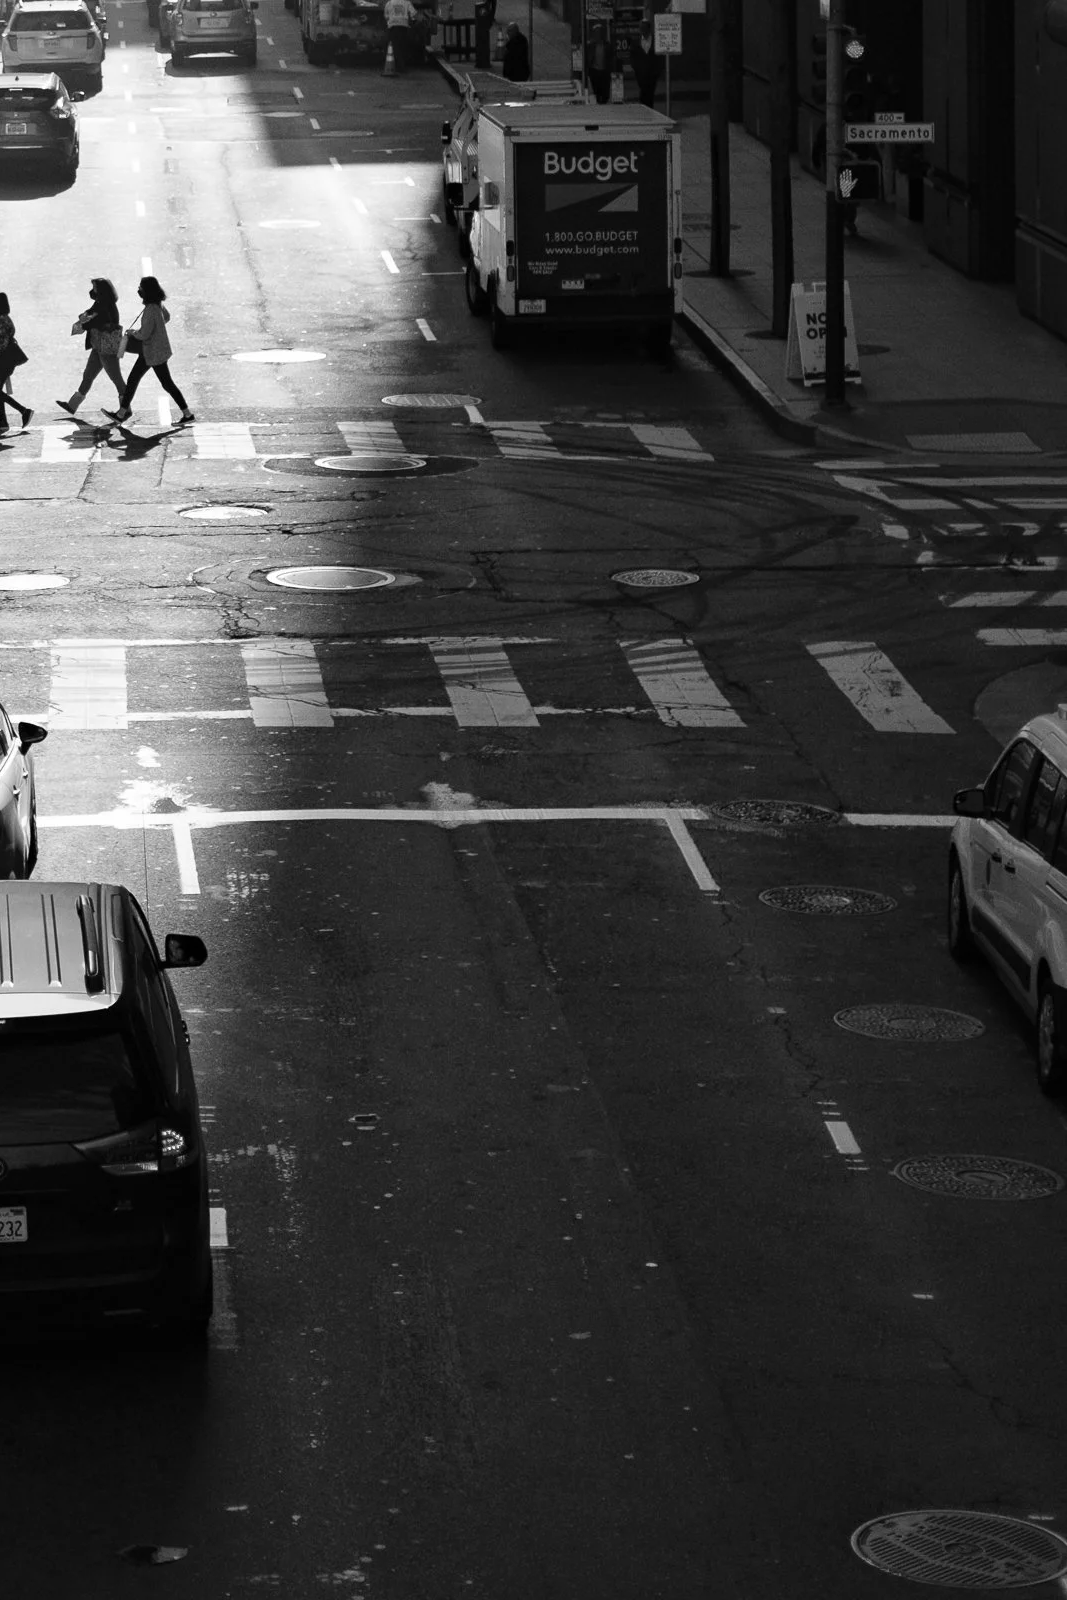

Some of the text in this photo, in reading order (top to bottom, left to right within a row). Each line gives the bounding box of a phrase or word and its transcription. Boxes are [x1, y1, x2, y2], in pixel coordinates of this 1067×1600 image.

[850, 127, 930, 139] Sacramento
[544, 151, 639, 181] Budget
[544, 230, 639, 242] 1.800.GO.BUDGET
[545, 244, 639, 257] www.budget.com
